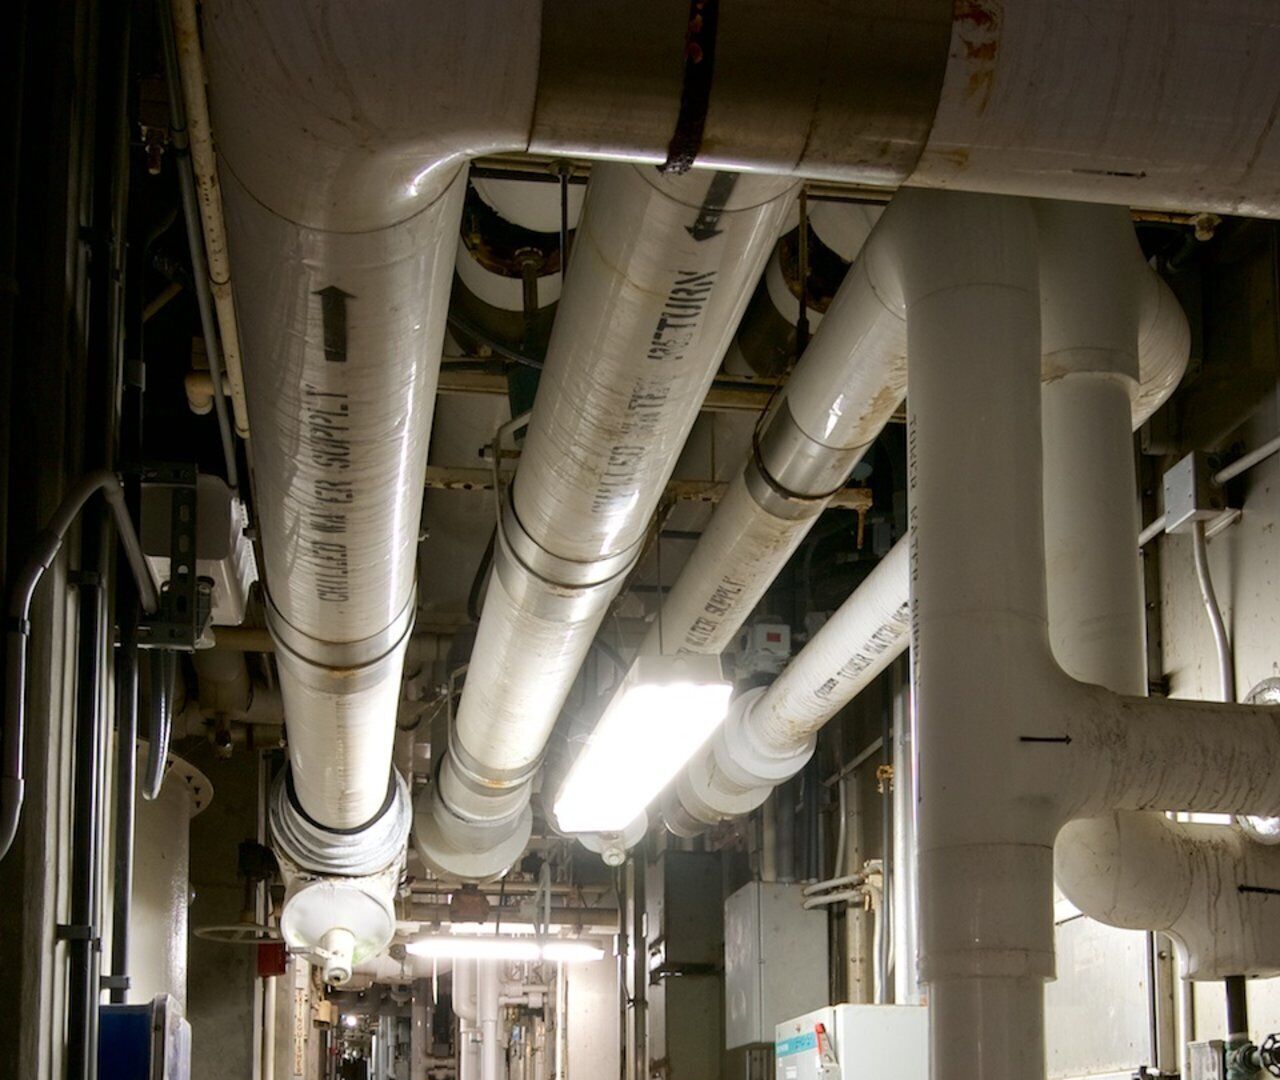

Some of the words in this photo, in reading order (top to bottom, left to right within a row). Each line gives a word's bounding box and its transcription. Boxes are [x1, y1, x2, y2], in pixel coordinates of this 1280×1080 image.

[305, 383, 351, 469] SUPPLY
[310, 479, 353, 533] WAER
[704, 575, 746, 617] SUPPLY
